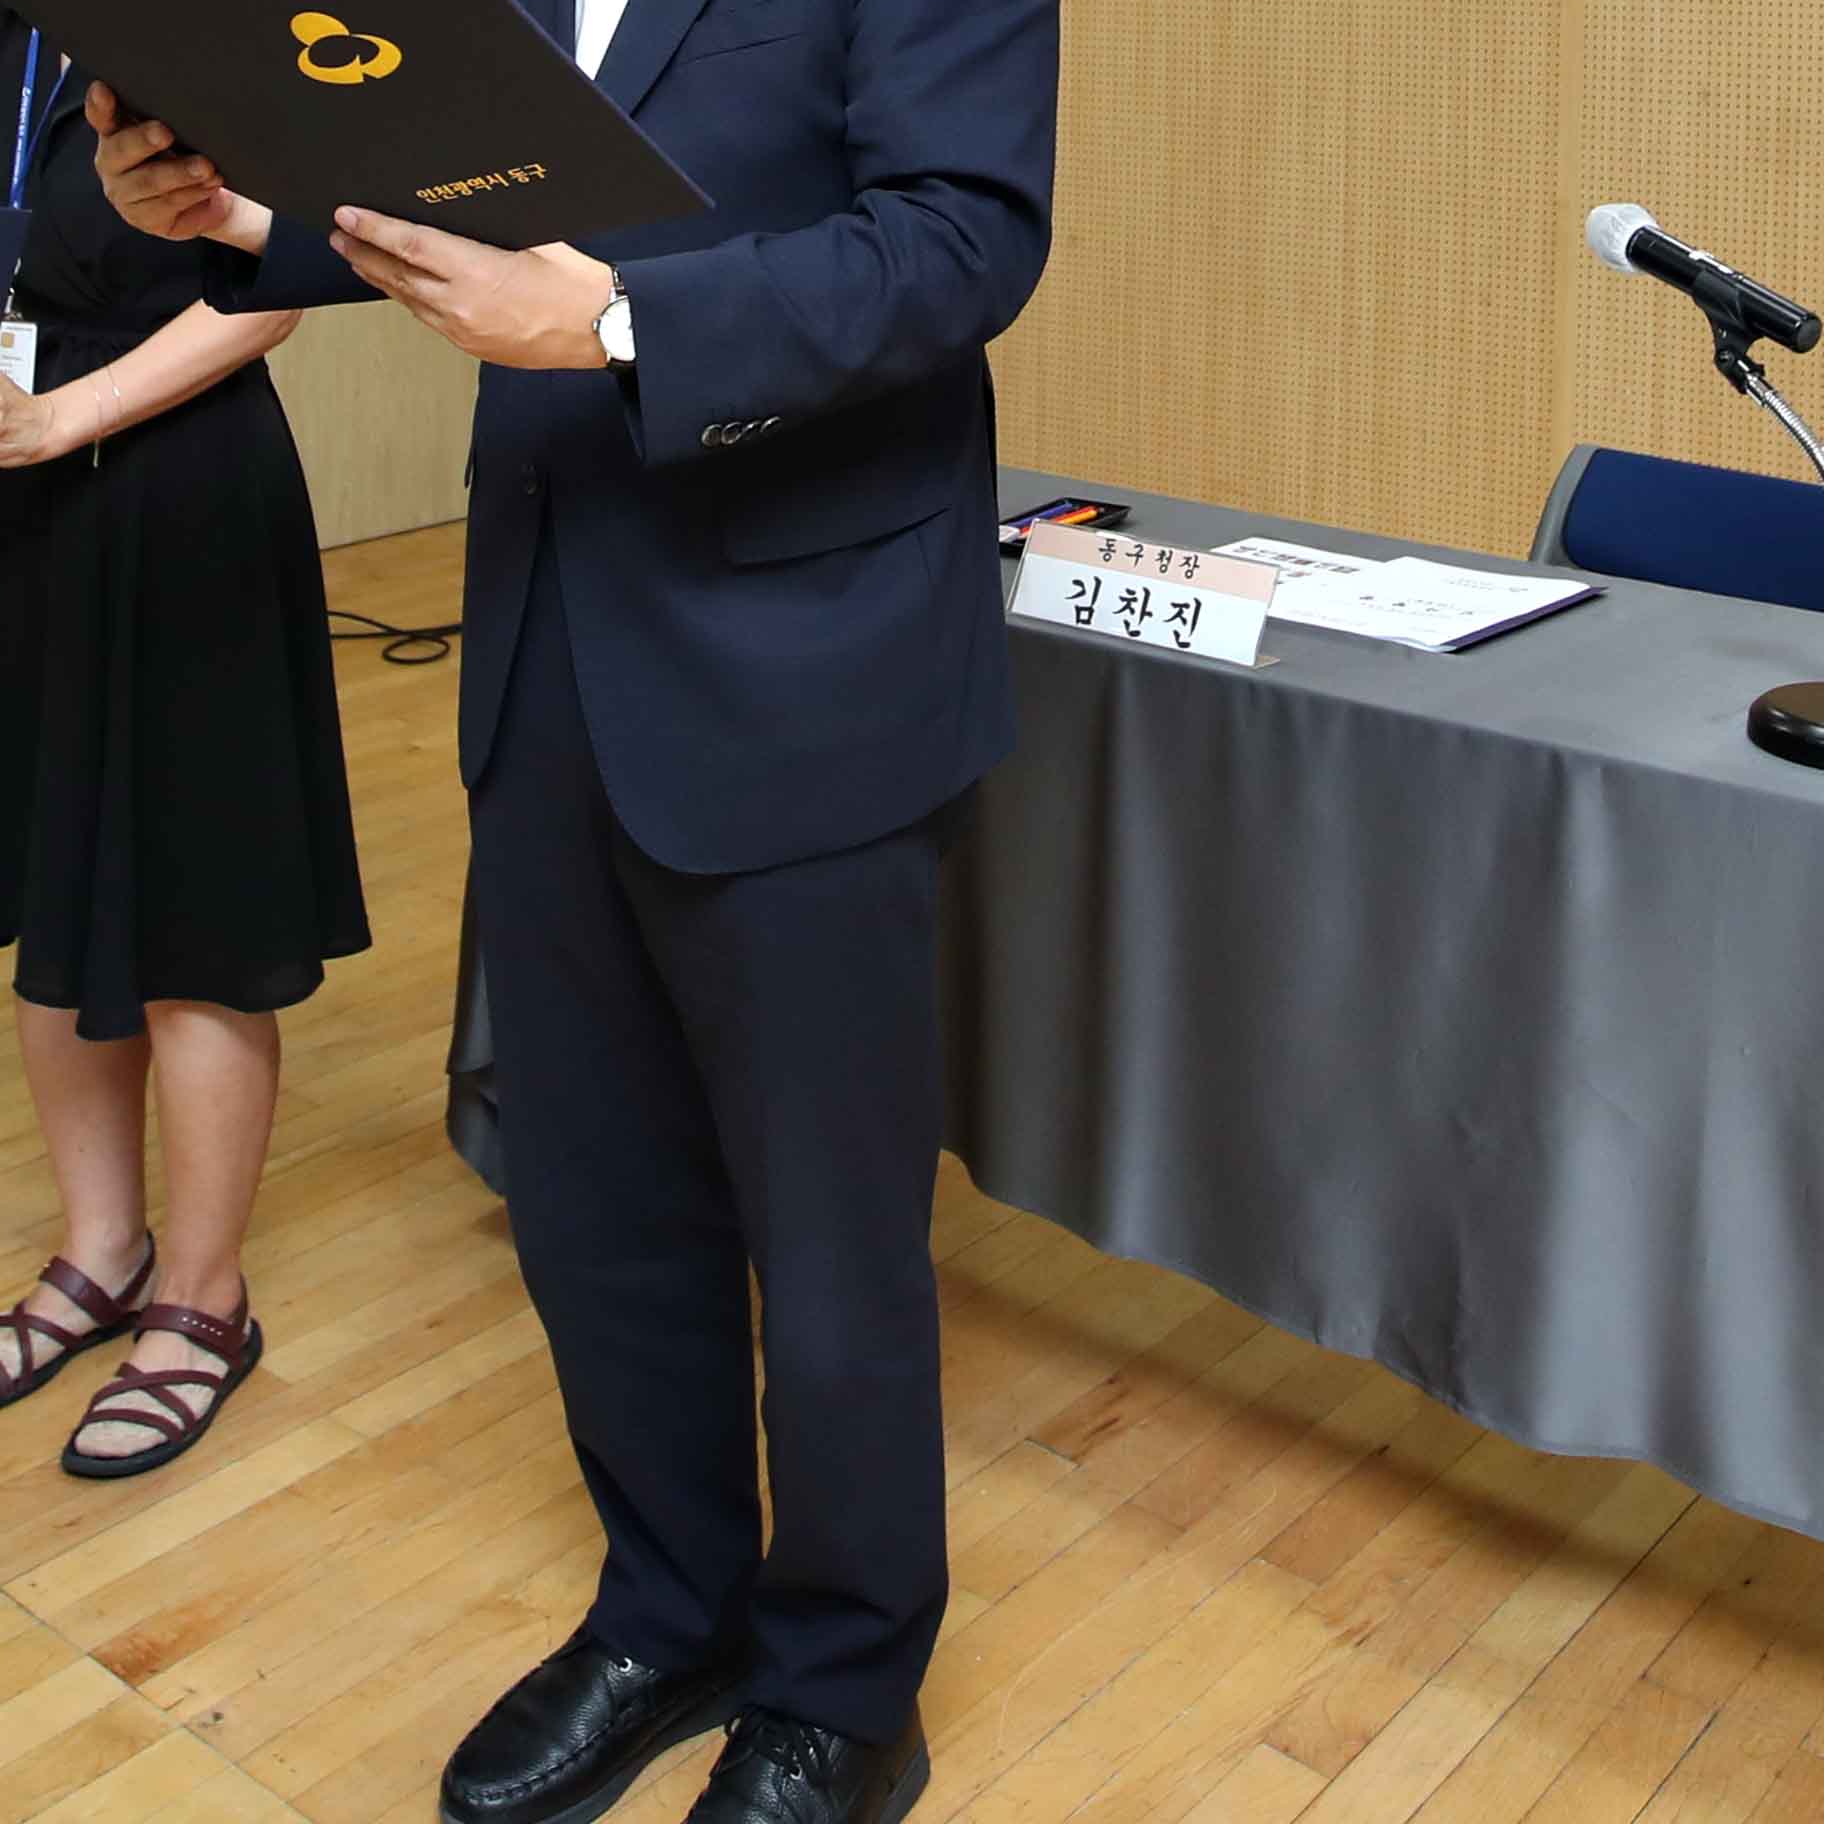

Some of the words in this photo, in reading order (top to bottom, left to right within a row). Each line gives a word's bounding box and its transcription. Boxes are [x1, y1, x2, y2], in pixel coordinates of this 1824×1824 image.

[415, 173, 510, 204] 인천광역시
[507, 163, 547, 183] 동구
[1098, 538, 1201, 579] 동구청장
[1064, 576, 1202, 649] 김찬진
